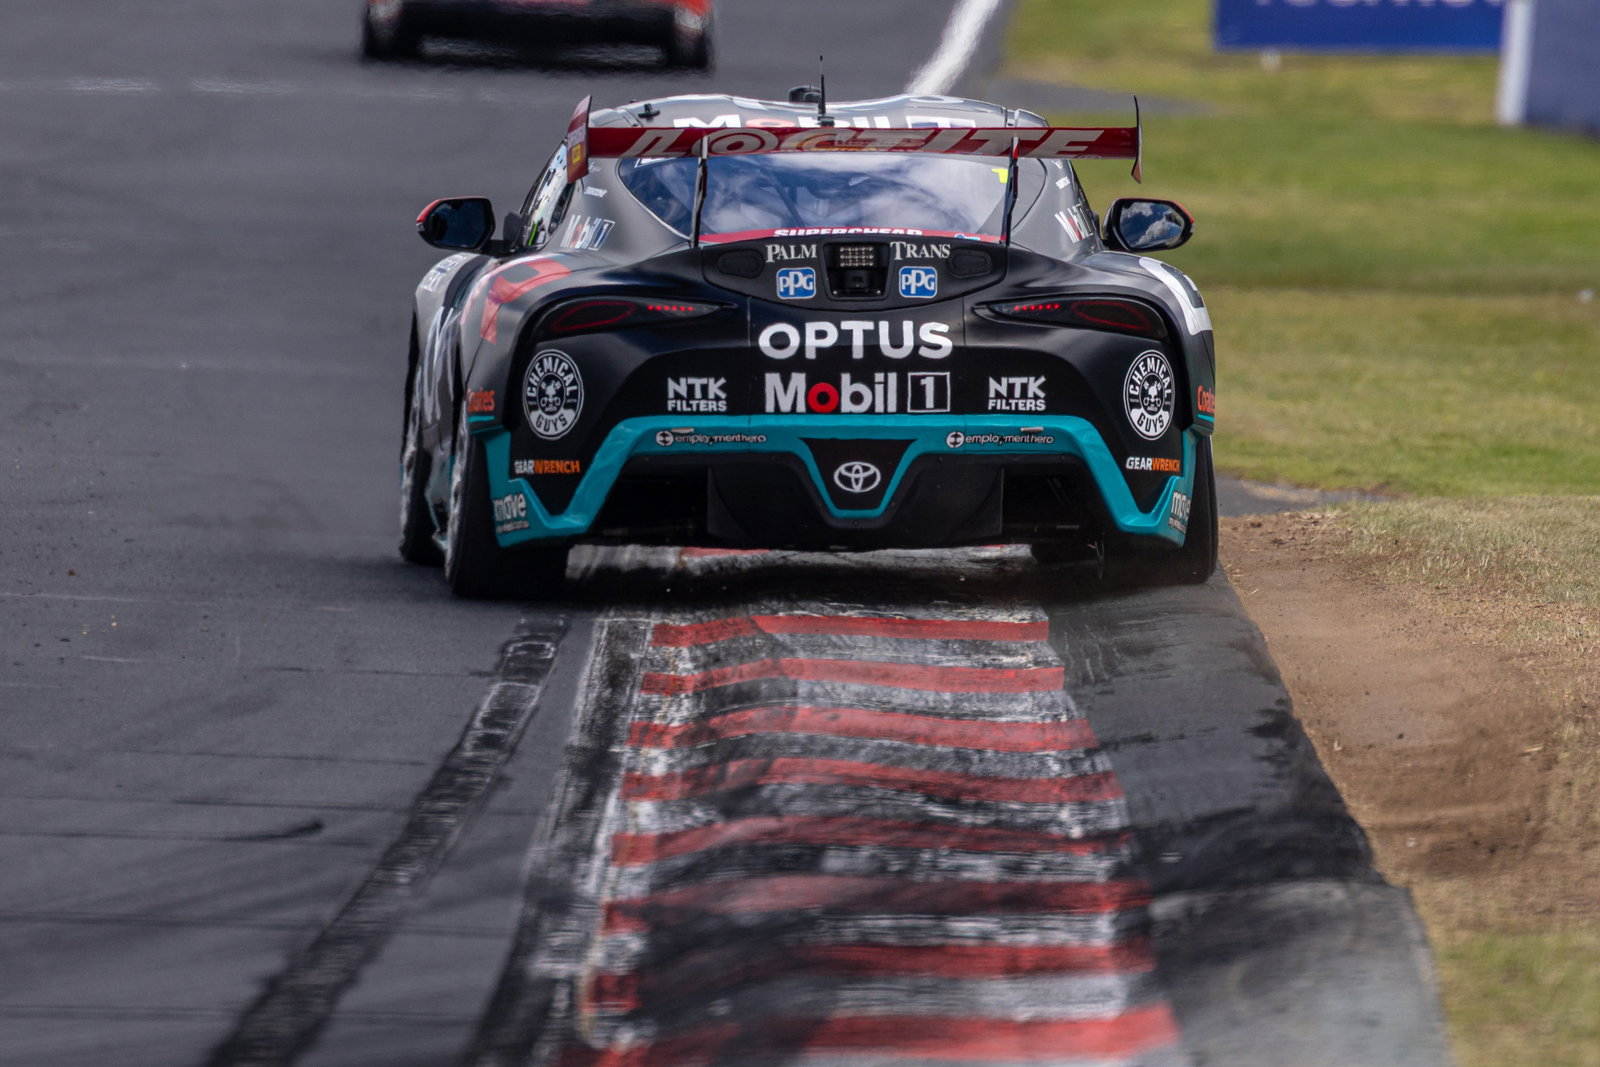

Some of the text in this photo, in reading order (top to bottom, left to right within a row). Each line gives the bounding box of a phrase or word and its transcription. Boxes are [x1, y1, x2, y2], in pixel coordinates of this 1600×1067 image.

[765, 241, 950, 263] PALM TRANS
[778, 271, 814, 295] PPG
[901, 269, 936, 294] PPG
[758, 320, 954, 360] OPTUS
[526, 356, 578, 396] CHEMICAL
[987, 376, 1047, 398] NTK
[1129, 357, 1172, 396] CHEMICAL
[667, 377, 727, 399] NTK
[764, 372, 898, 413] Mobil
[667, 399, 727, 413] FILTERS
[987, 399, 1047, 412] FILTERS
[535, 413, 568, 433] GUYS
[1137, 414, 1165, 434] GUYS
[675, 433, 767, 445] emplomenthero
[965, 433, 1054, 445] emplomenthero
[514, 459, 581, 474] GEARWRENCH
[1125, 456, 1181, 473] GEARWRENCH
